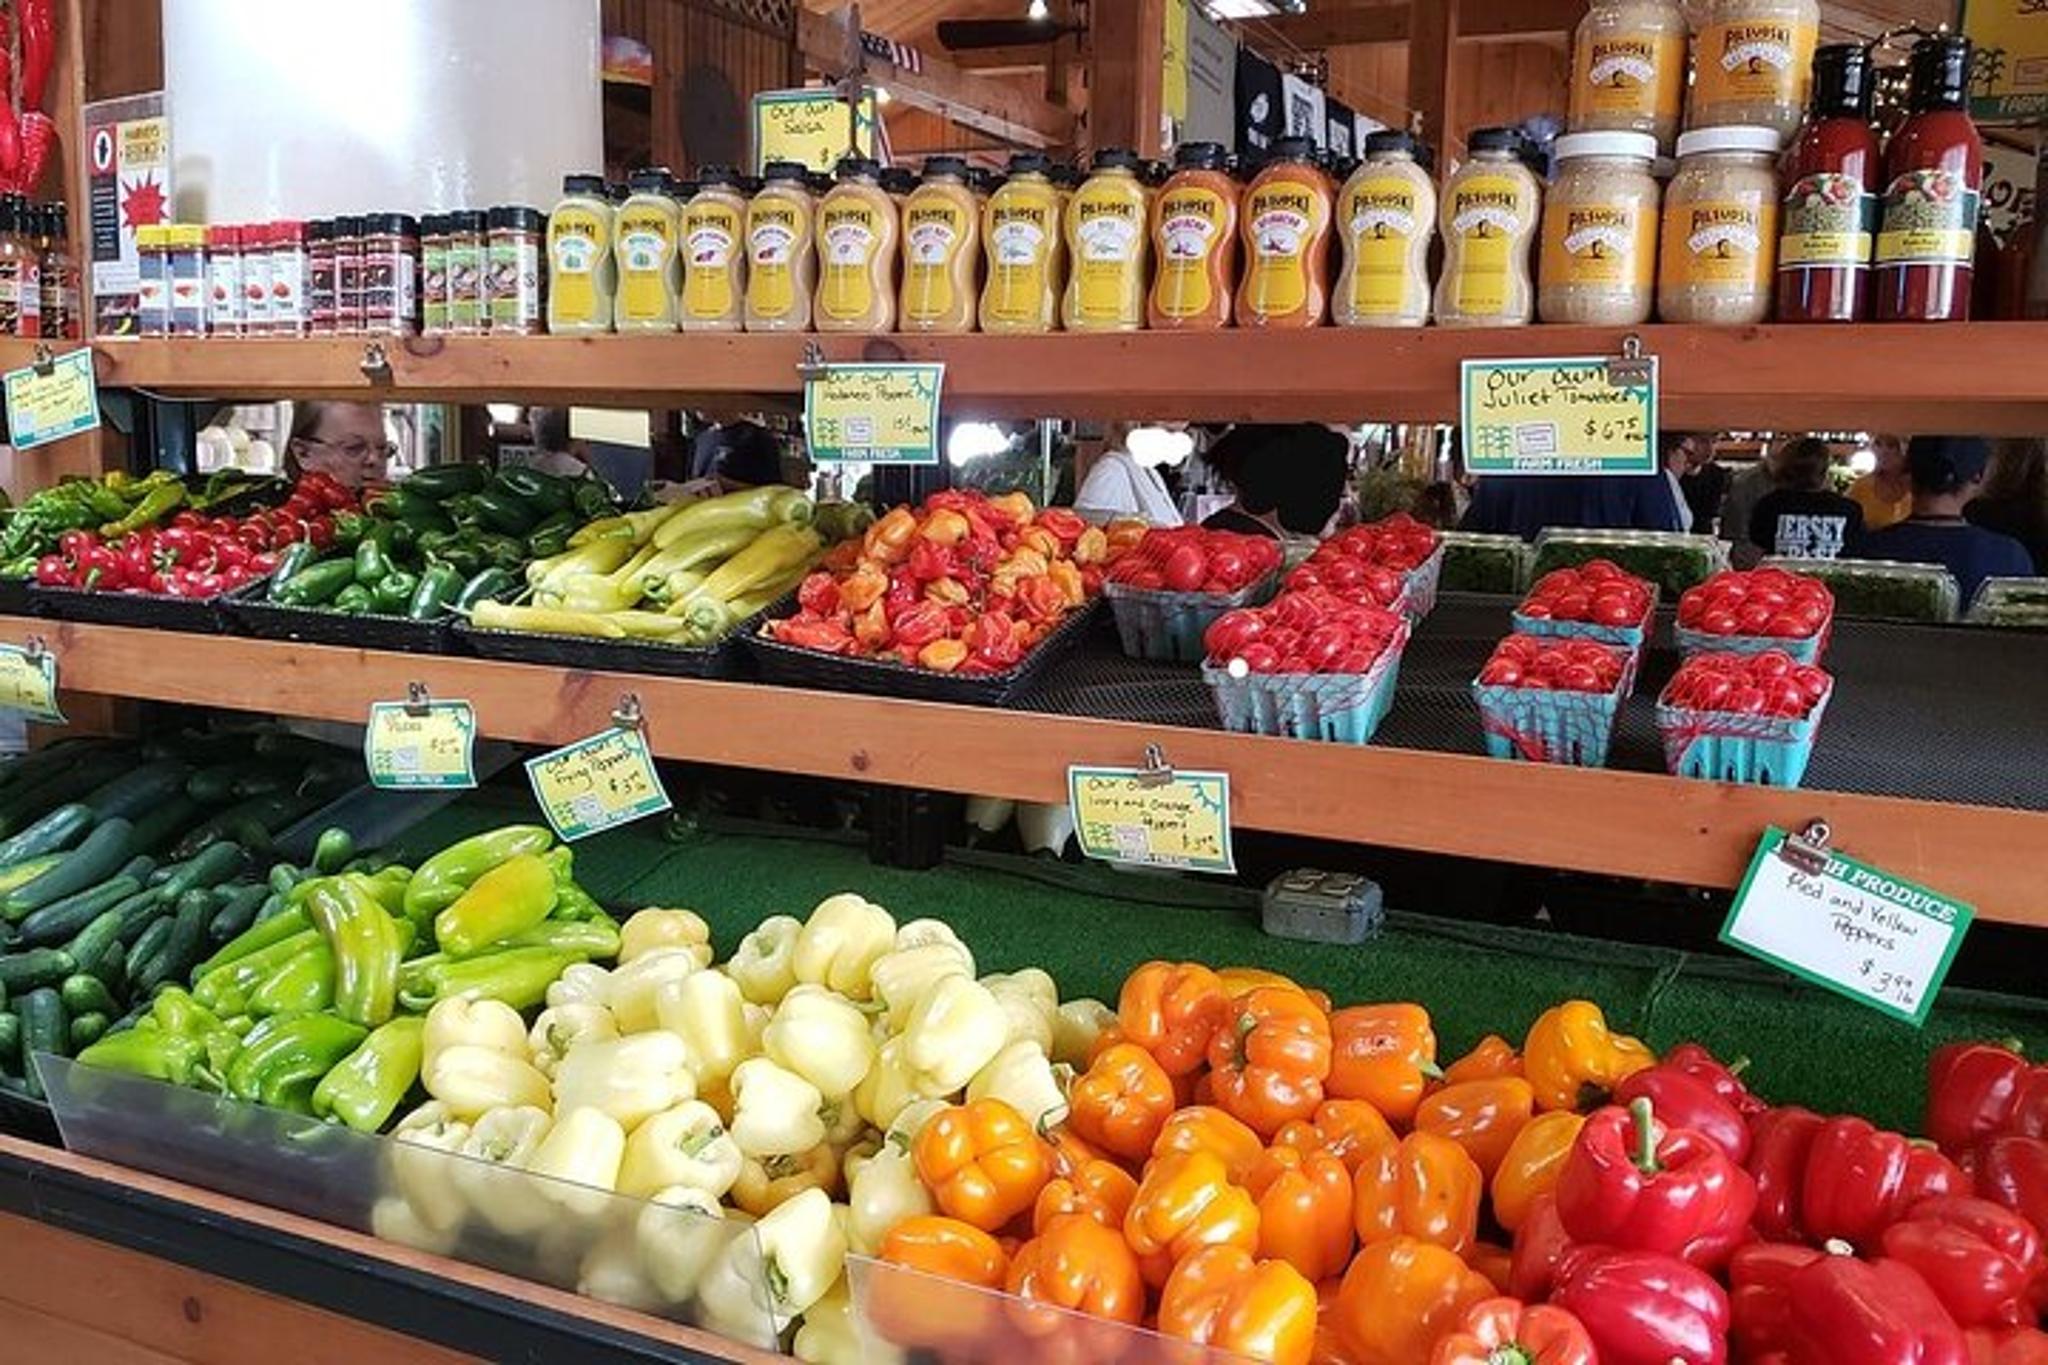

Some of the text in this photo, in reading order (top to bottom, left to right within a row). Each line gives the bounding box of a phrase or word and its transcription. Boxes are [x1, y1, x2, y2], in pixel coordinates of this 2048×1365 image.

[1486, 366, 1607, 391] Our Own
[1482, 388, 1552, 410] Juliet
[1774, 513, 1848, 540] JERSEY
[1088, 798, 1120, 811] Ivory
[1123, 799, 1145, 809] and
[1786, 870, 1919, 937] Red and Yellow
[1850, 863, 1958, 924] PRODUCE
[1829, 911, 1895, 951] Peppers
